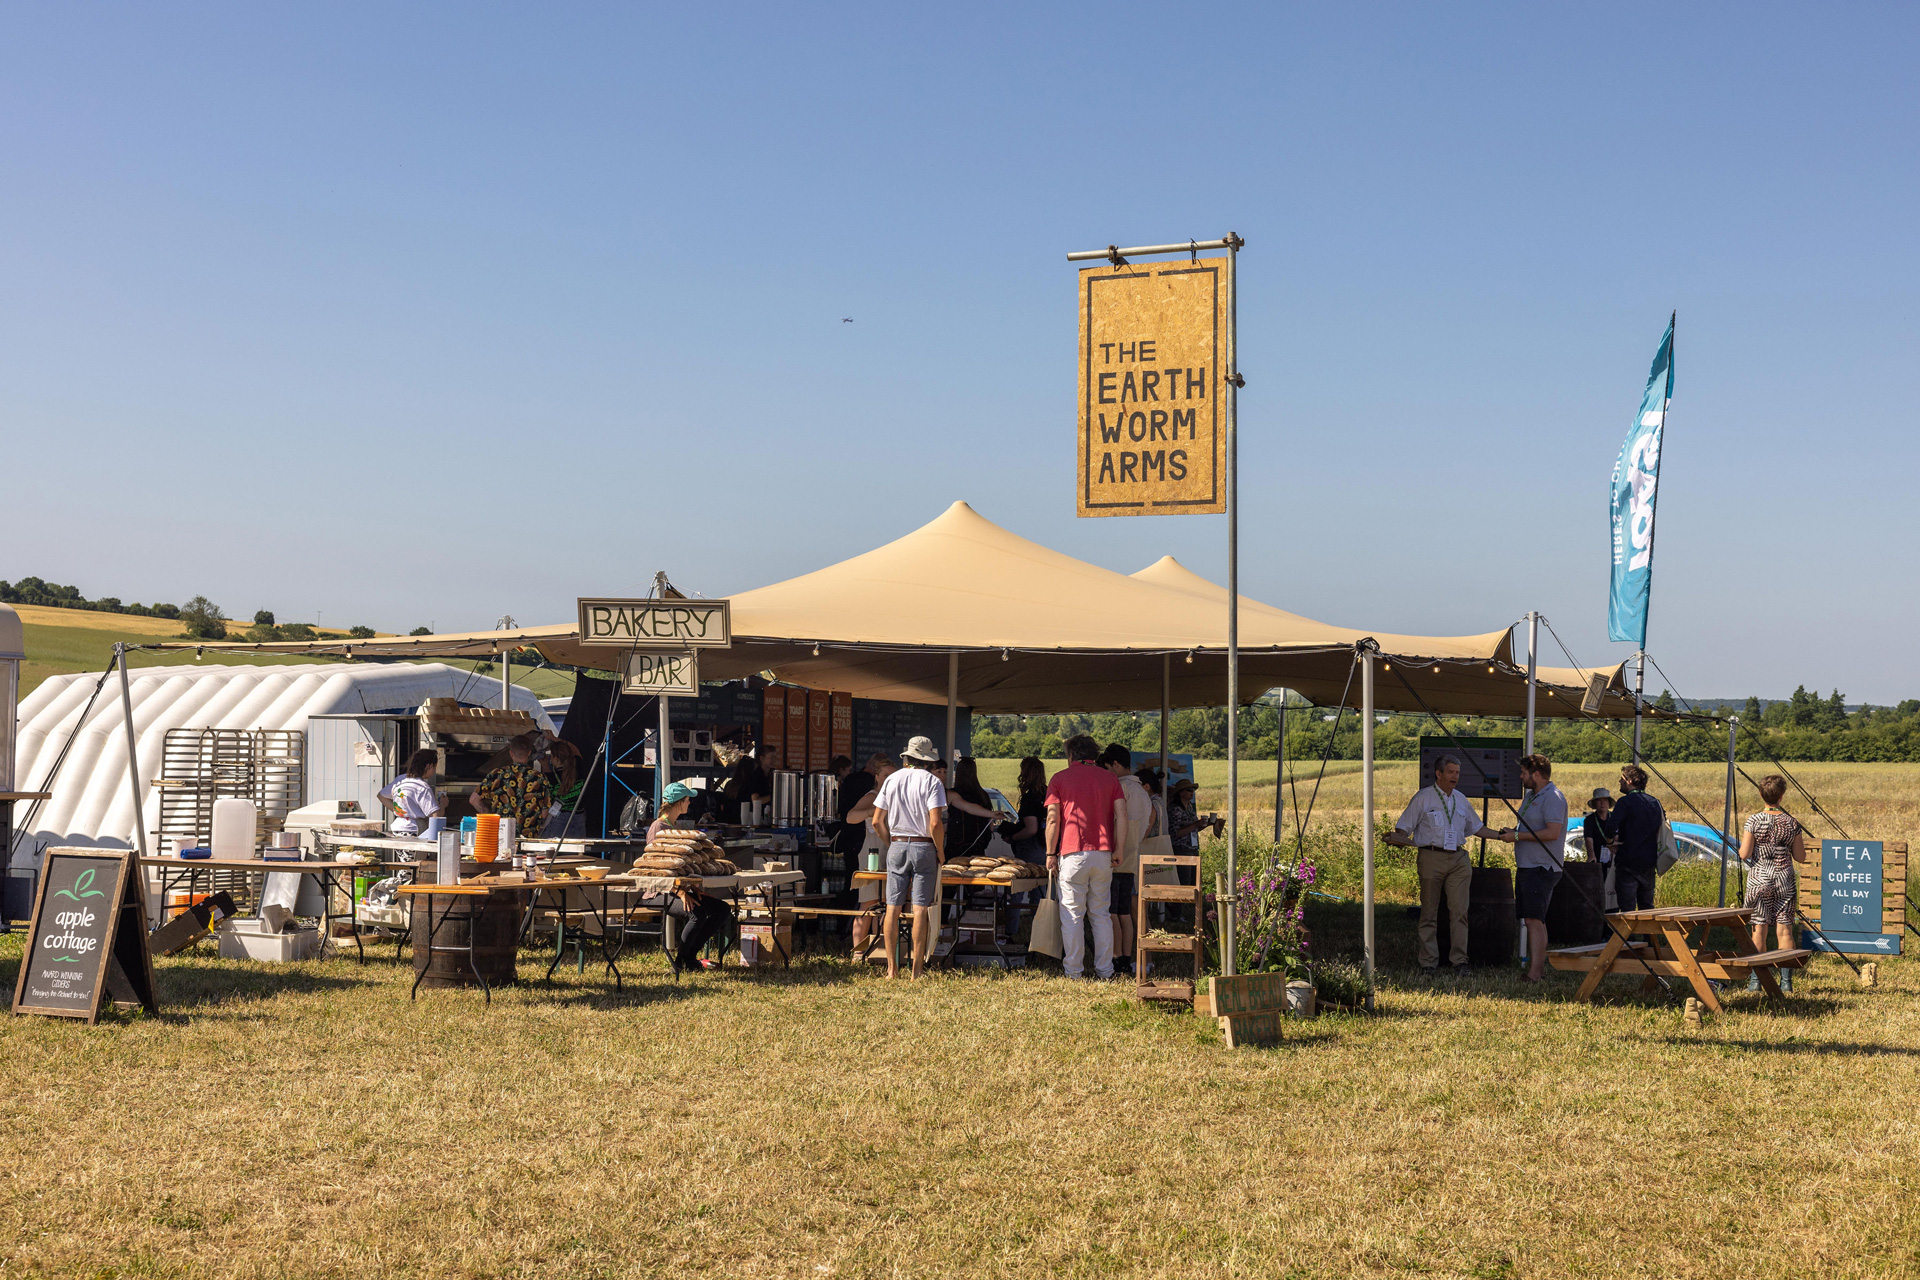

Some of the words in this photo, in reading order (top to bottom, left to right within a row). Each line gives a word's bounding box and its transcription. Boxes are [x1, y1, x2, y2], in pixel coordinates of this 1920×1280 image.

[1099, 340, 1156, 364] THE
[1098, 367, 1206, 404] EARTH
[1098, 407, 1196, 444] WORM
[1098, 449, 1188, 484] ARMS
[592, 607, 716, 638] BAKERY
[638, 655, 687, 685] BAR
[789, 705, 805, 715] TOAST
[833, 705, 851, 718] FREE
[833, 719, 851, 730] STAR
[1832, 846, 1871, 861] TEA
[1828, 872, 1871, 883] COFFEE
[1832, 889, 1849, 897] ALL
[1852, 890, 1870, 898] DAY
[55, 906, 95, 929] apple
[43, 930, 97, 955] cottage
[41, 969, 60, 979] AWARD
[60, 971, 83, 981] WINNING
[51, 979, 71, 989] CIDERS
[1216, 978, 1246, 1014] REAL
[1247, 975, 1282, 1011] BREAD
[1233, 1013, 1279, 1047] BAKERY
